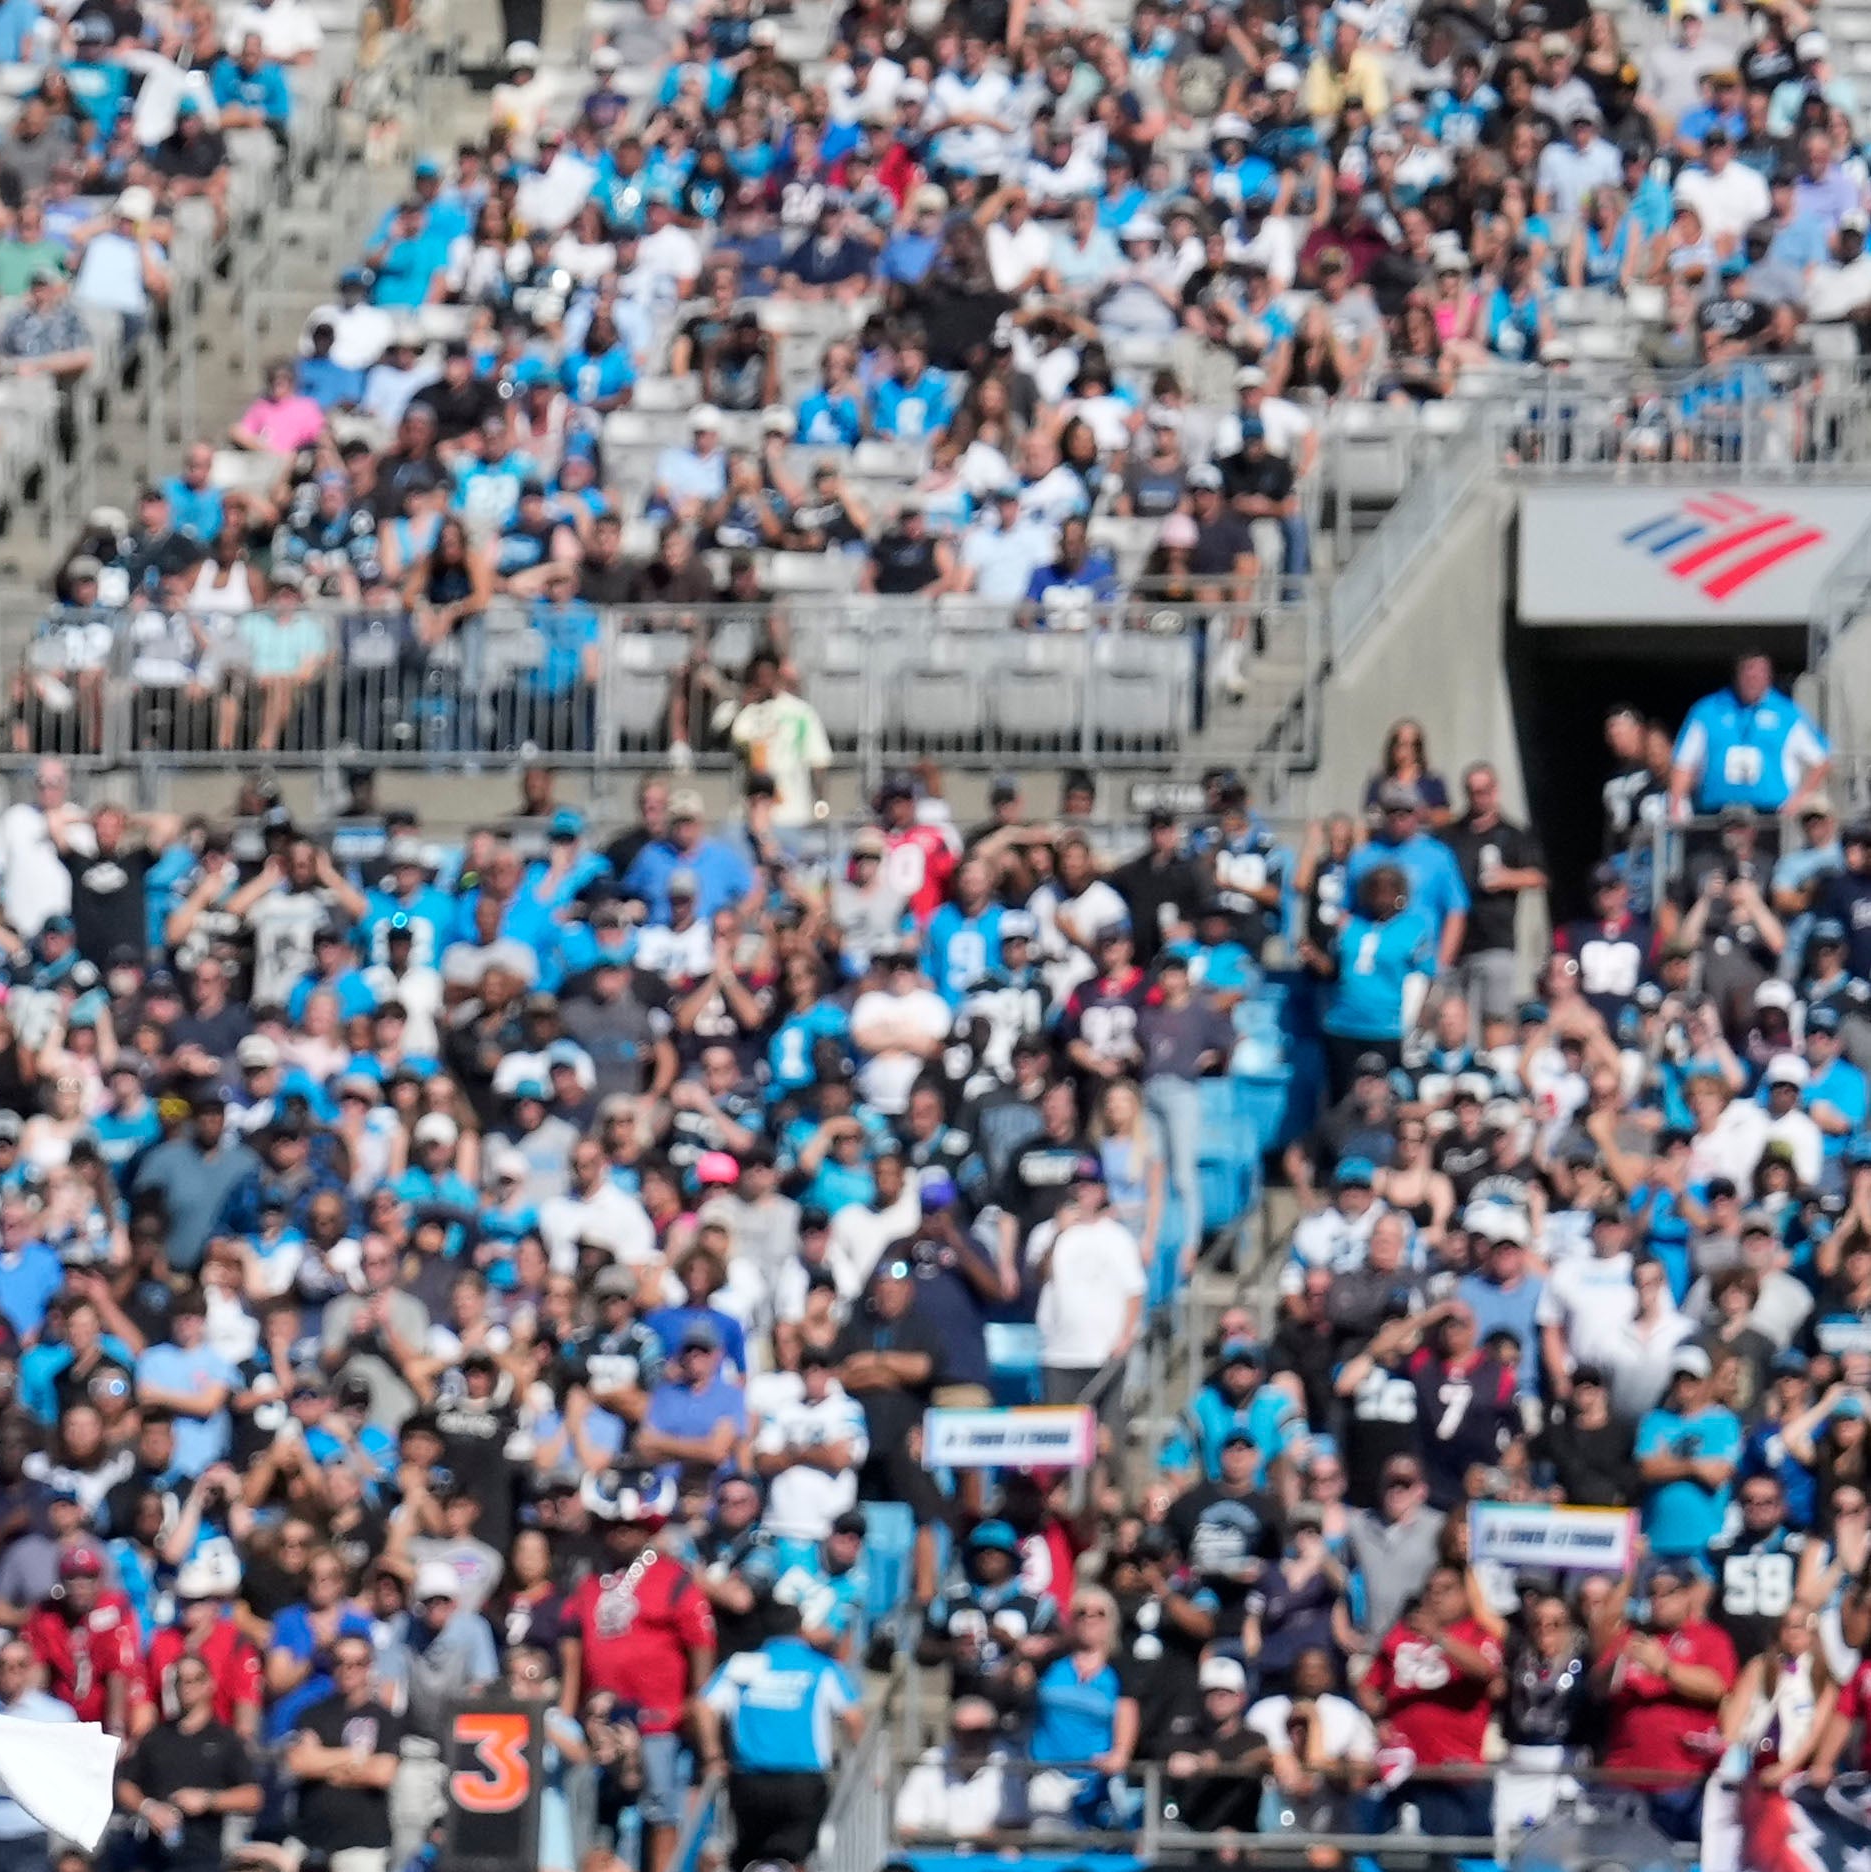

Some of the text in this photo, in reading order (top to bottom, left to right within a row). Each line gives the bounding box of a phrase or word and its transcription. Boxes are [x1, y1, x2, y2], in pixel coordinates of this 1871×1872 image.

[1436, 1384, 1473, 1441] 7
[1723, 1553, 1793, 1617] 58
[449, 1713, 530, 1813] 3
